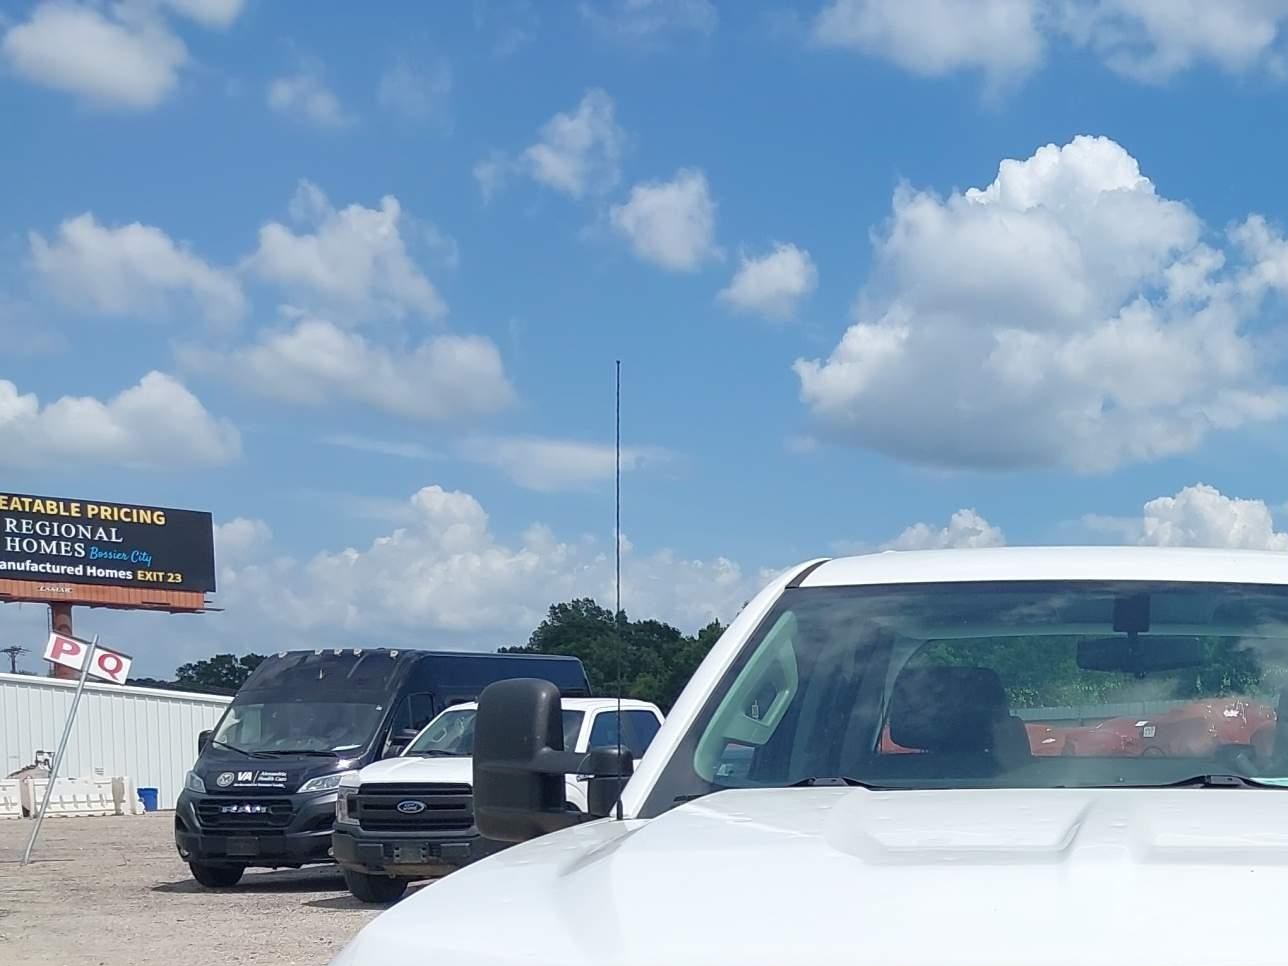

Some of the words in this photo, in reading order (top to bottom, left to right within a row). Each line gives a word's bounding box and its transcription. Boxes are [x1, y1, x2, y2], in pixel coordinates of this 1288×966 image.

[87, 504, 166, 525] PRICING
[5, 518, 124, 543] REGIONAL
[5, 537, 86, 558] HOMES
[90, 547, 129, 561] Bossier
[131, 550, 153, 567] City
[87, 566, 133, 580] Homes
[137, 570, 165, 583] EXIT
[167, 572, 183, 584] 23
[50, 636, 80, 660] P
[98, 653, 123, 681] Q
[238, 771, 253, 781] VA
